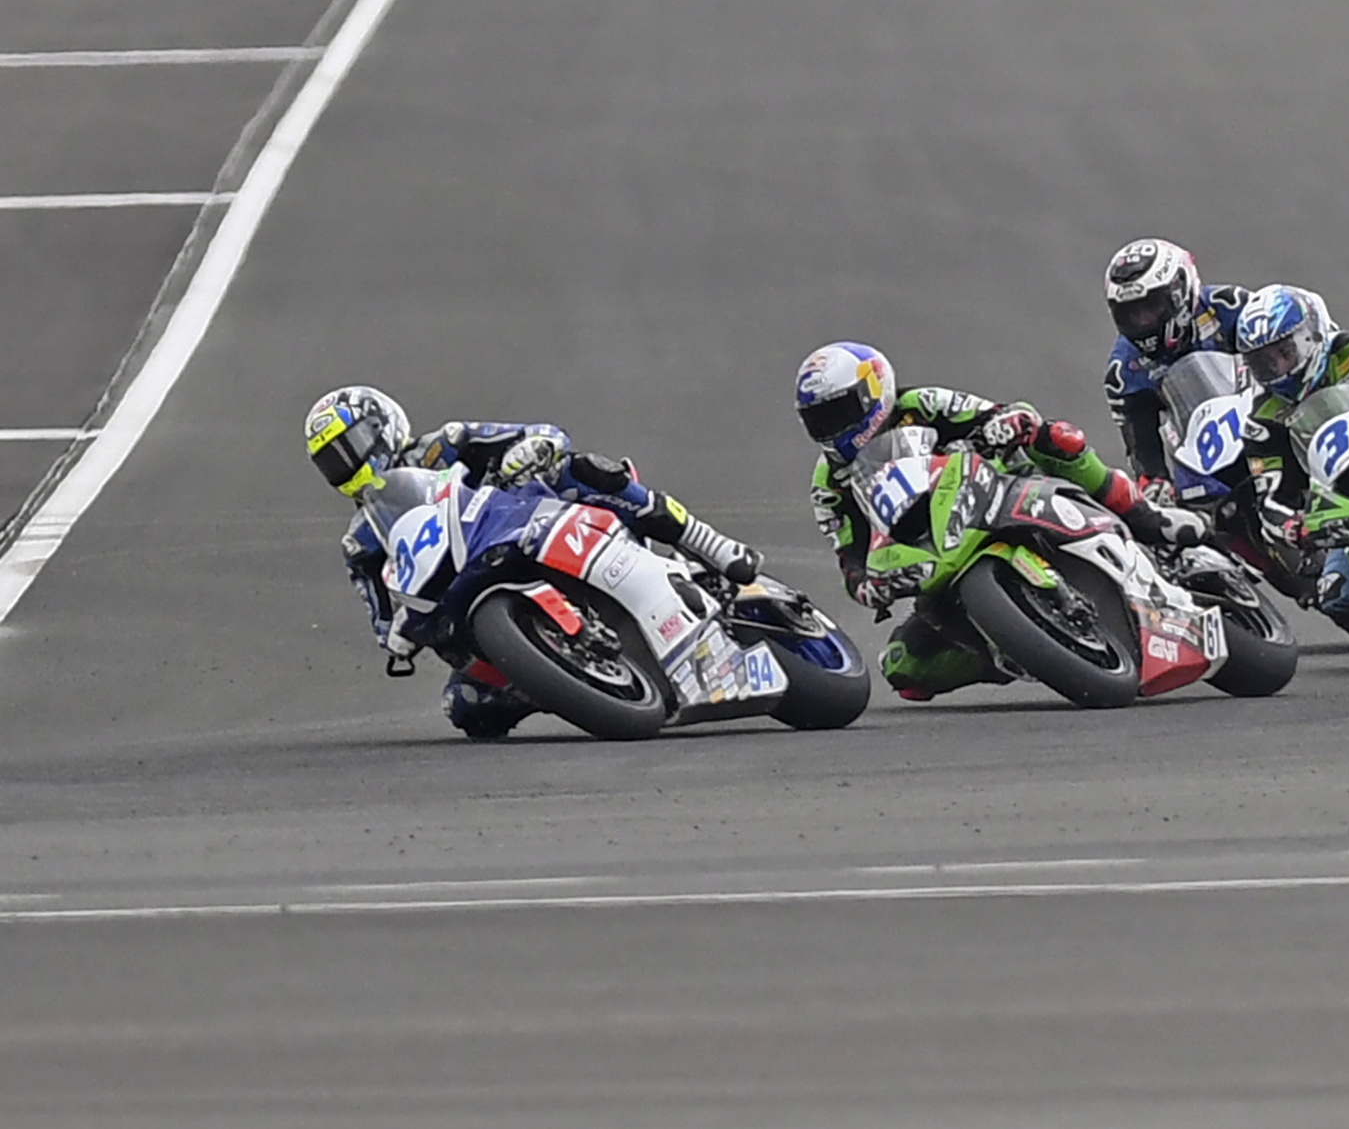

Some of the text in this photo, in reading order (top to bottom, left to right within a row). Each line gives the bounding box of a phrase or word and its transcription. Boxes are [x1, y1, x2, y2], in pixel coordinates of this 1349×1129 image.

[1196, 407, 1241, 471] 81
[1316, 419, 1349, 477] 3
[872, 466, 916, 527] 61
[396, 514, 443, 594] 94
[748, 652, 773, 691] 94
